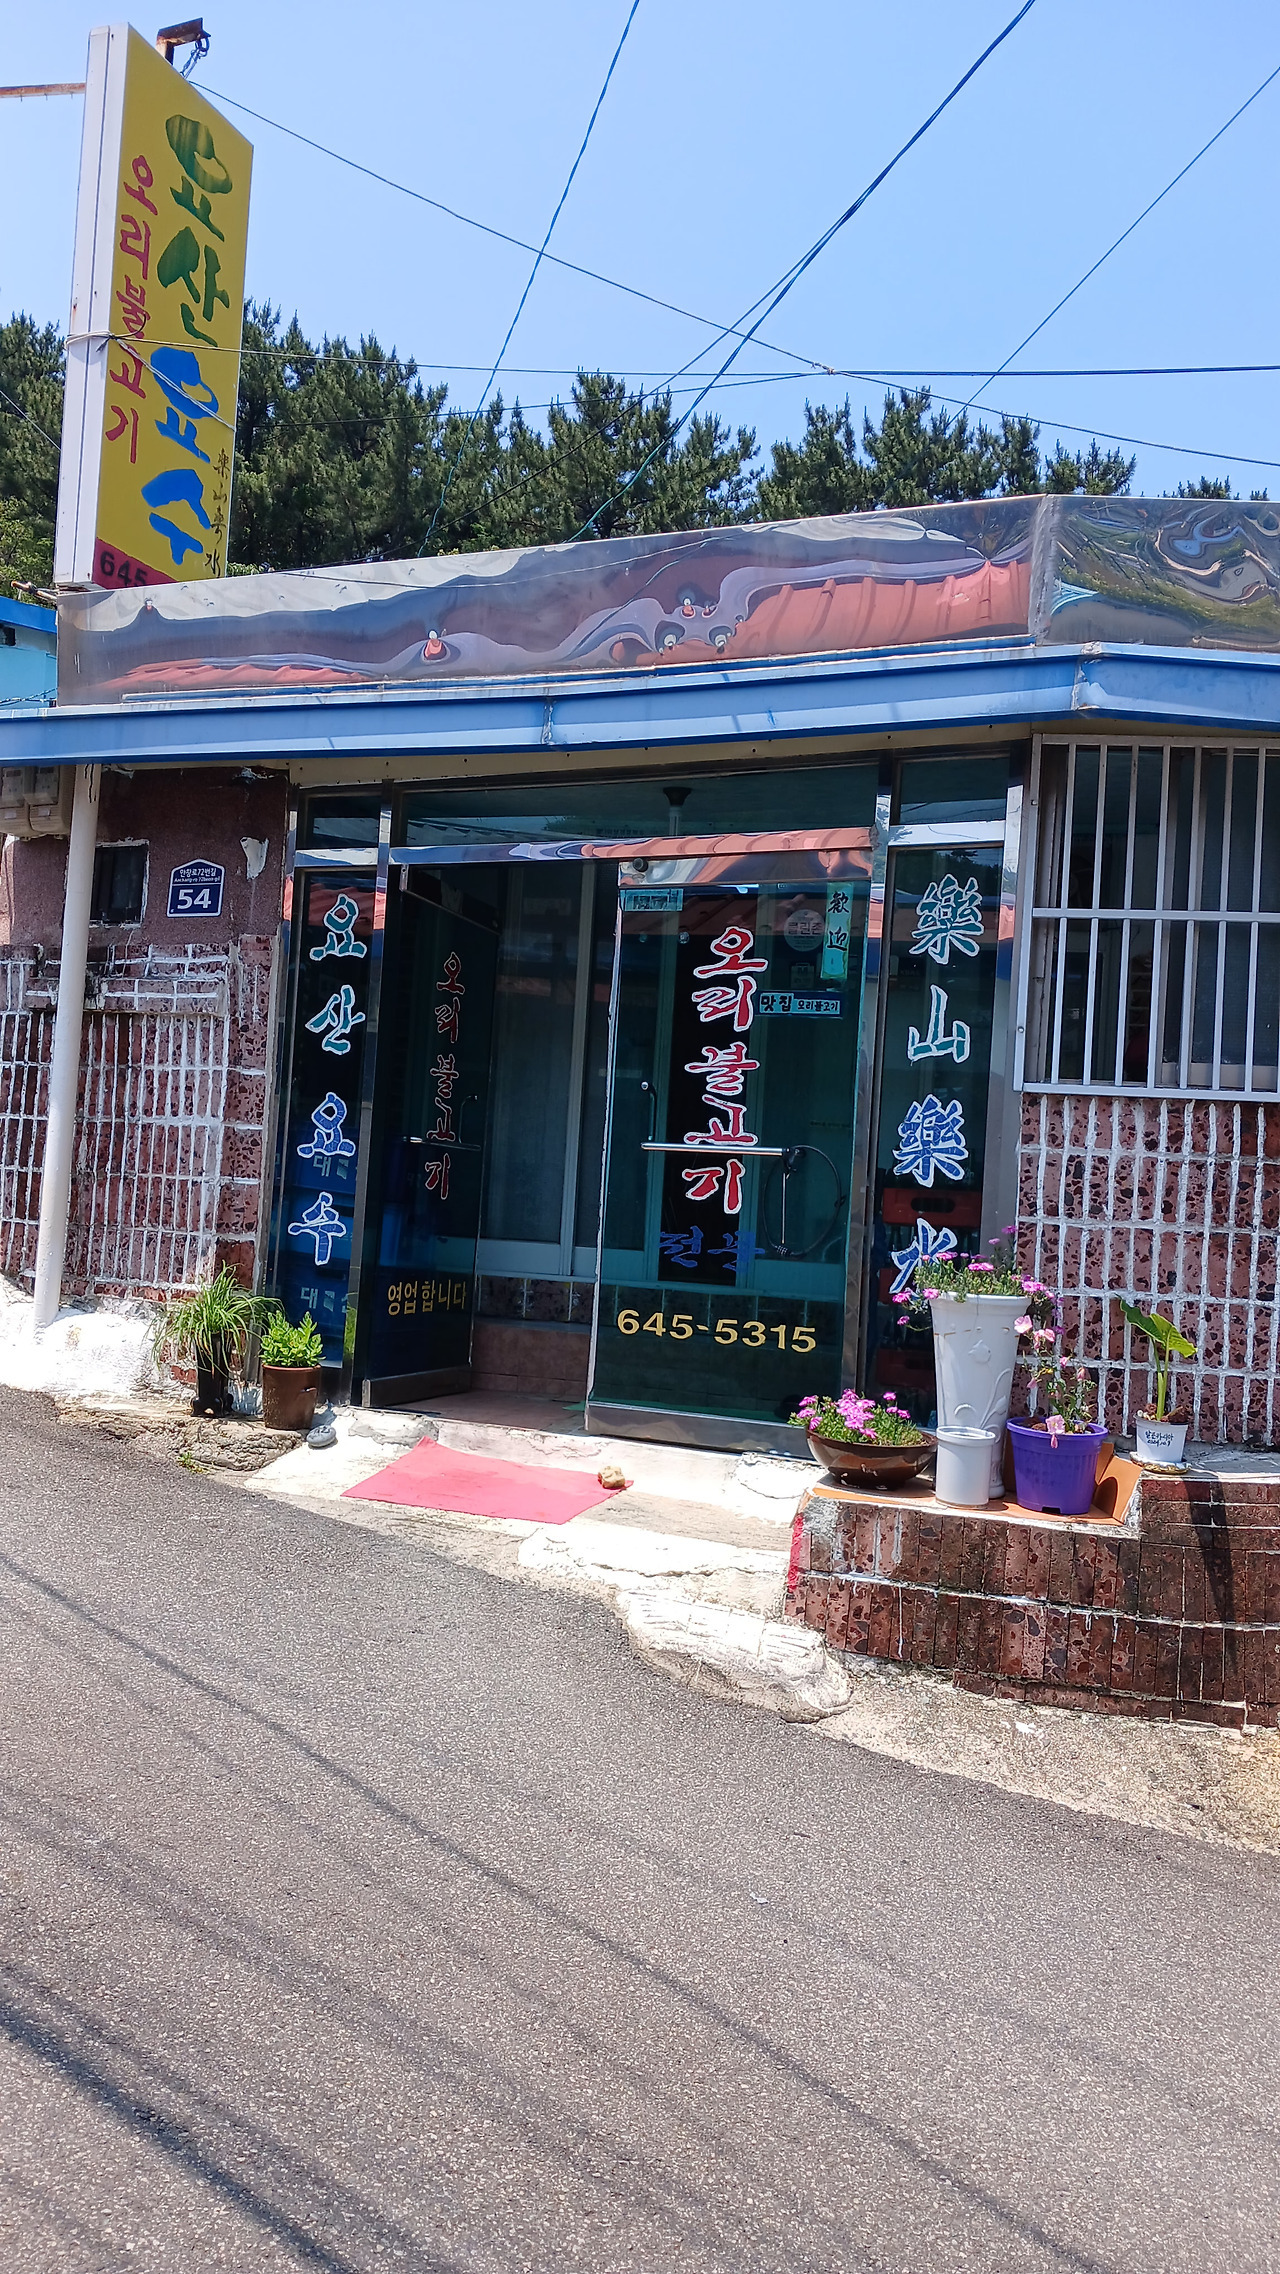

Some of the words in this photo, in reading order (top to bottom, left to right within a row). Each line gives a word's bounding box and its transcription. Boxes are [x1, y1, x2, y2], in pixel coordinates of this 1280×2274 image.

[141, 114, 233, 566] 요산요수
[100, 551, 148, 587] 645
[177, 888, 212, 910] 54
[288, 893, 368, 1267] 요산요수
[684, 926, 769, 1214] 오리불고기
[387, 1279, 467, 1316] 영업합니다
[616, 1309, 818, 1354] 645-5315
